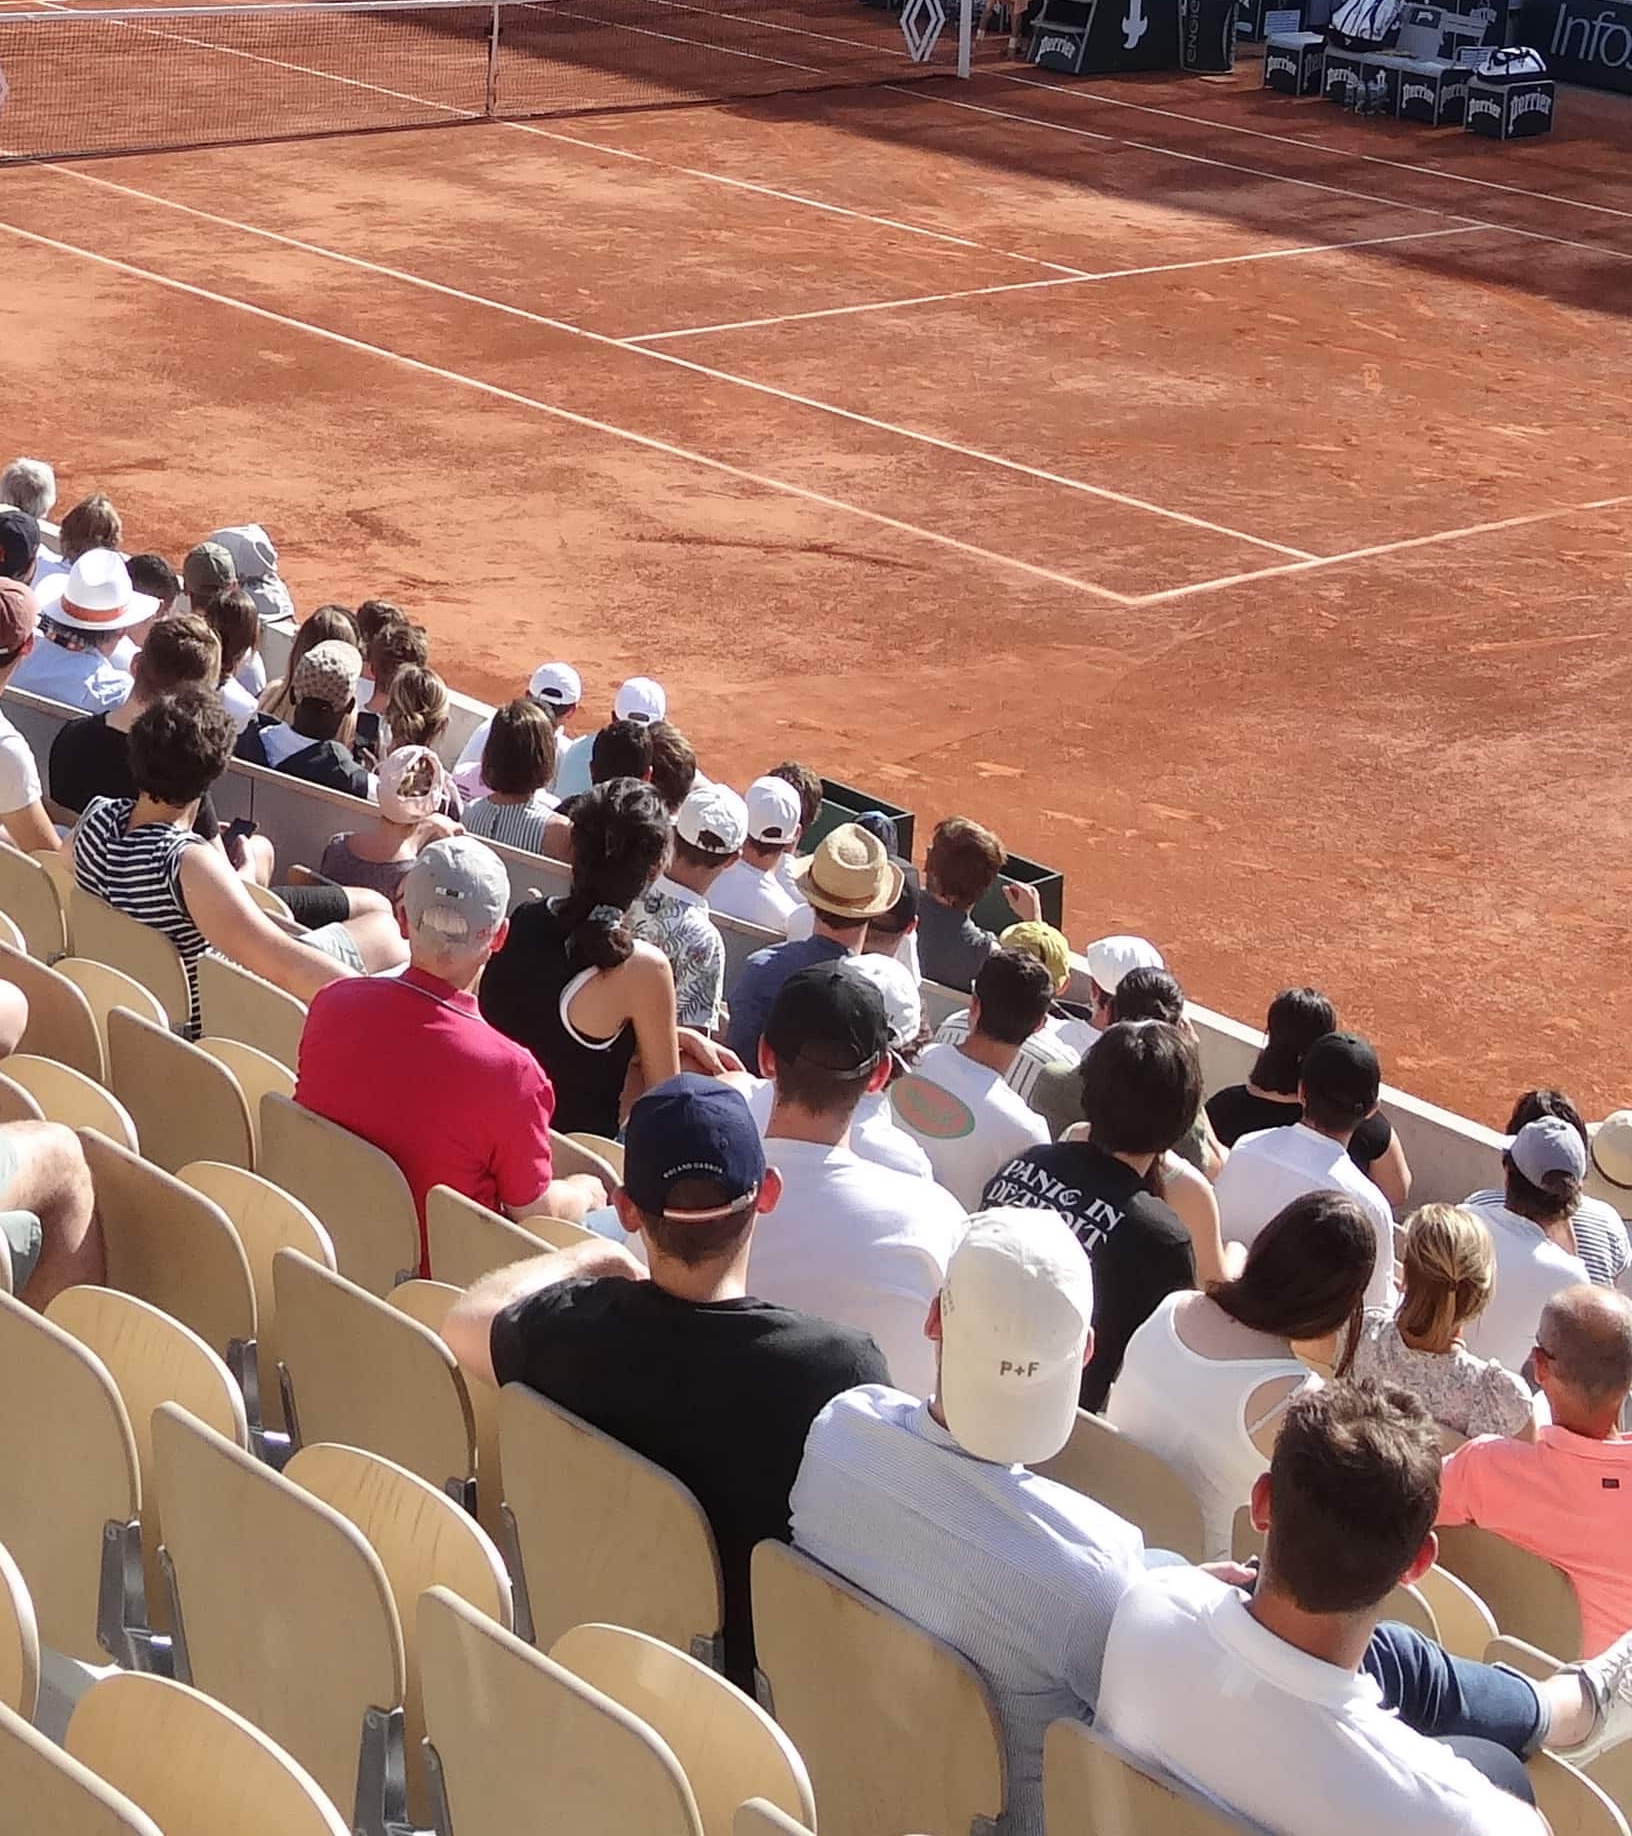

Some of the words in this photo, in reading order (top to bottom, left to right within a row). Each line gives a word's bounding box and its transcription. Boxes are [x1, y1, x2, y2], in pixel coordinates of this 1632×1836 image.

[1509, 86, 1553, 135] perrier
[1001, 1159, 1082, 1206] PANIC
[1083, 1197, 1126, 1233] IN
[999, 1361, 1040, 1378] P+F
